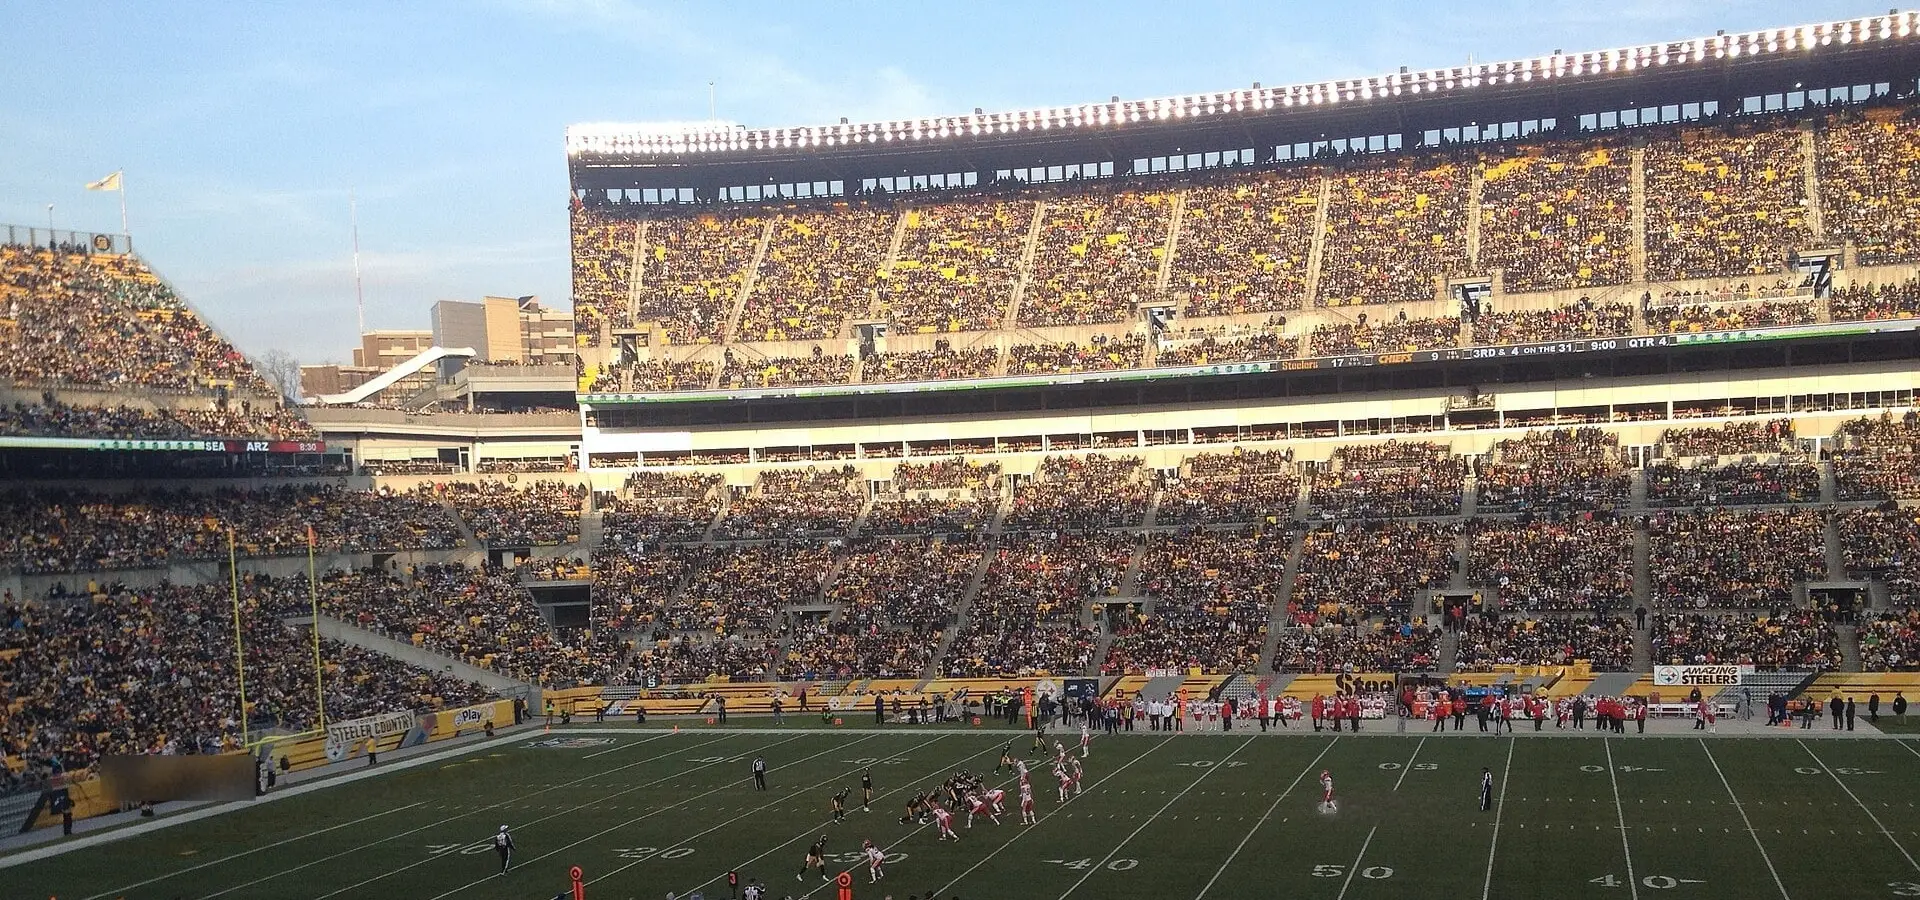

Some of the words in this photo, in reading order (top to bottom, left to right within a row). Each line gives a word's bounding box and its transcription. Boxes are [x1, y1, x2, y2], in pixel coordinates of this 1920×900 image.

[1331, 359, 1344, 368] 17
[1379, 353, 1413, 364] CHIEFS
[1431, 352, 1439, 361] 9
[1473, 348, 1496, 358] 3RD
[1498, 348, 1506, 356] &
[1511, 346, 1519, 355] 4
[1538, 345, 1556, 353] THE
[1558, 343, 1572, 352] 31
[1591, 340, 1616, 350] 9:00
[1628, 338, 1655, 348] QTR
[1658, 336, 1667, 346] 4
[205, 441, 226, 452] SEA
[246, 441, 269, 452] ARZ
[299, 442, 317, 452] 8:30
[1682, 666, 1738, 675] AMAZING
[1682, 675, 1738, 685] STEELERS
[330, 724, 373, 743] STEELER
[374, 712, 414, 735] COUNTRY
[1311, 864, 1394, 879] 50
[1588, 874, 1678, 889] 40
